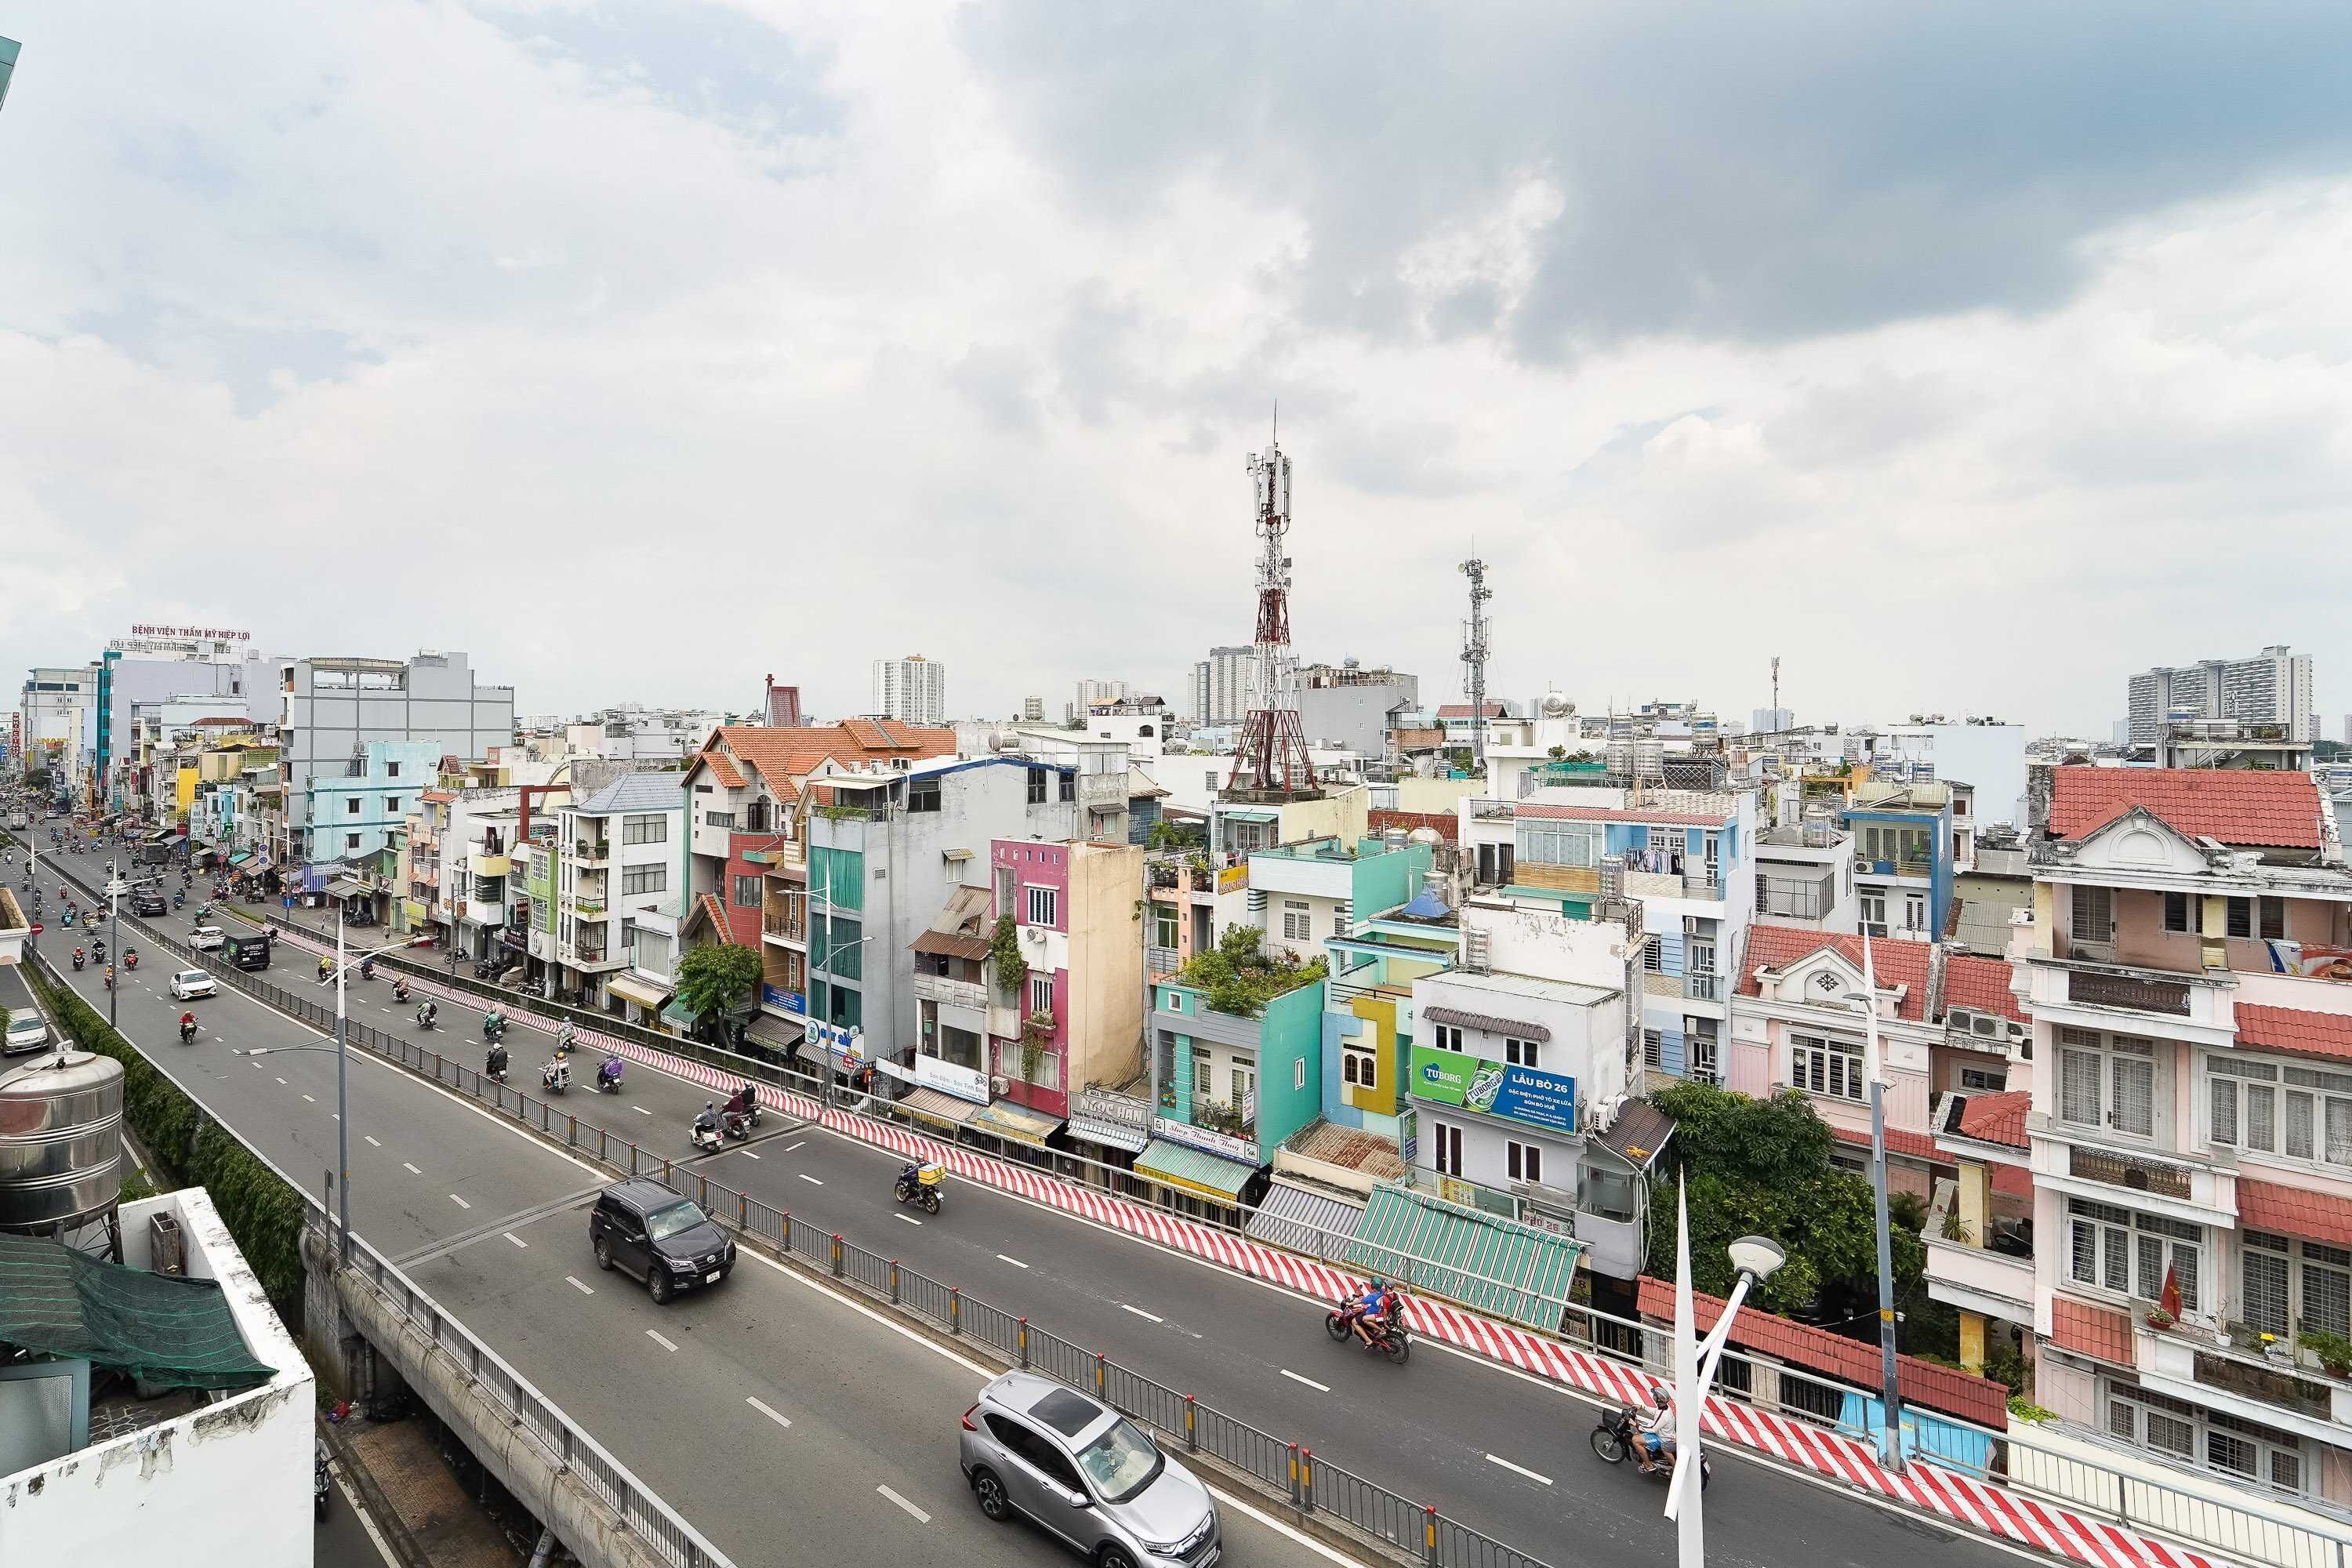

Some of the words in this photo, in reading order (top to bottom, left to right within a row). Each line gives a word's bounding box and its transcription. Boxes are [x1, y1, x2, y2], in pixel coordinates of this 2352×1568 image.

[132, 625, 155, 635] BỆNH
[157, 626, 176, 637] VIỆN
[178, 626, 202, 638] THẨM
[205, 628, 216, 639] MỸ
[1426, 1067, 1461, 1084] TUBORG
[1468, 1078, 1497, 1100] TUBORG
[1536, 1079, 1552, 1089] BÒ
[1554, 1083, 1568, 1093] 26
[1081, 1095, 1113, 1115] NGỌC
[1117, 1105, 1143, 1123] HÂN
[1169, 1124, 1188, 1136] Shop
[1191, 1131, 1216, 1144] Thanh
[1546, 1221, 1559, 1231] 26
